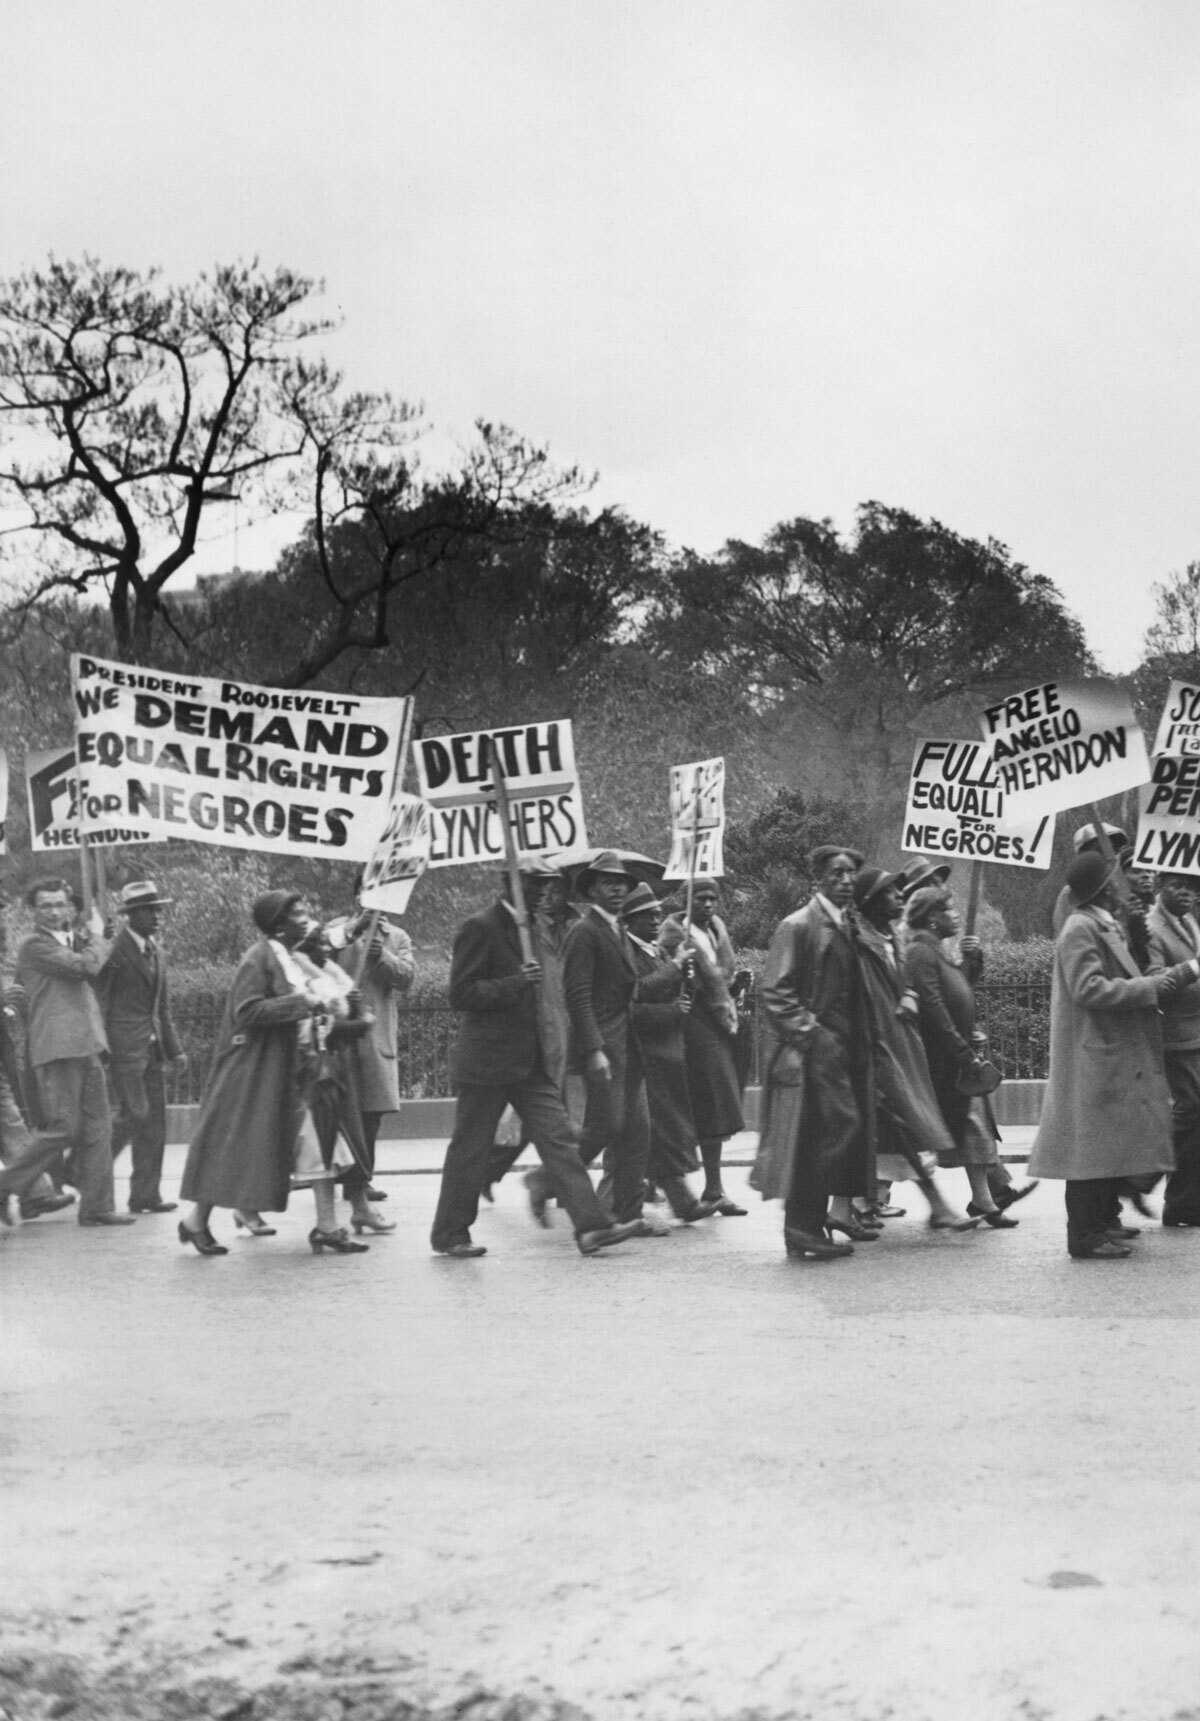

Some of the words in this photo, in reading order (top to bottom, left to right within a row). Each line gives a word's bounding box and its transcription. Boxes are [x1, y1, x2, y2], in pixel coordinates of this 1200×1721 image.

[79, 658, 202, 698] PRESIDENT
[222, 682, 360, 716] ROOSEVELT
[984, 683, 1060, 733] FREE
[75, 687, 120, 718] WE
[134, 695, 389, 758] DEMAND
[992, 708, 1081, 762] ANGELO
[78, 732, 220, 779] EQUAL
[225, 743, 385, 797] RIGHTS
[422, 723, 562, 789] DEATH
[913, 742, 999, 788] FULL
[1000, 726, 1126, 794] HERNDON
[128, 779, 354, 847] NEGROES
[430, 795, 576, 861] LYNCHERS
[912, 781, 1003, 818] EQUALI
[957, 815, 996, 832] FOR
[906, 815, 1049, 864] NEGROES!
